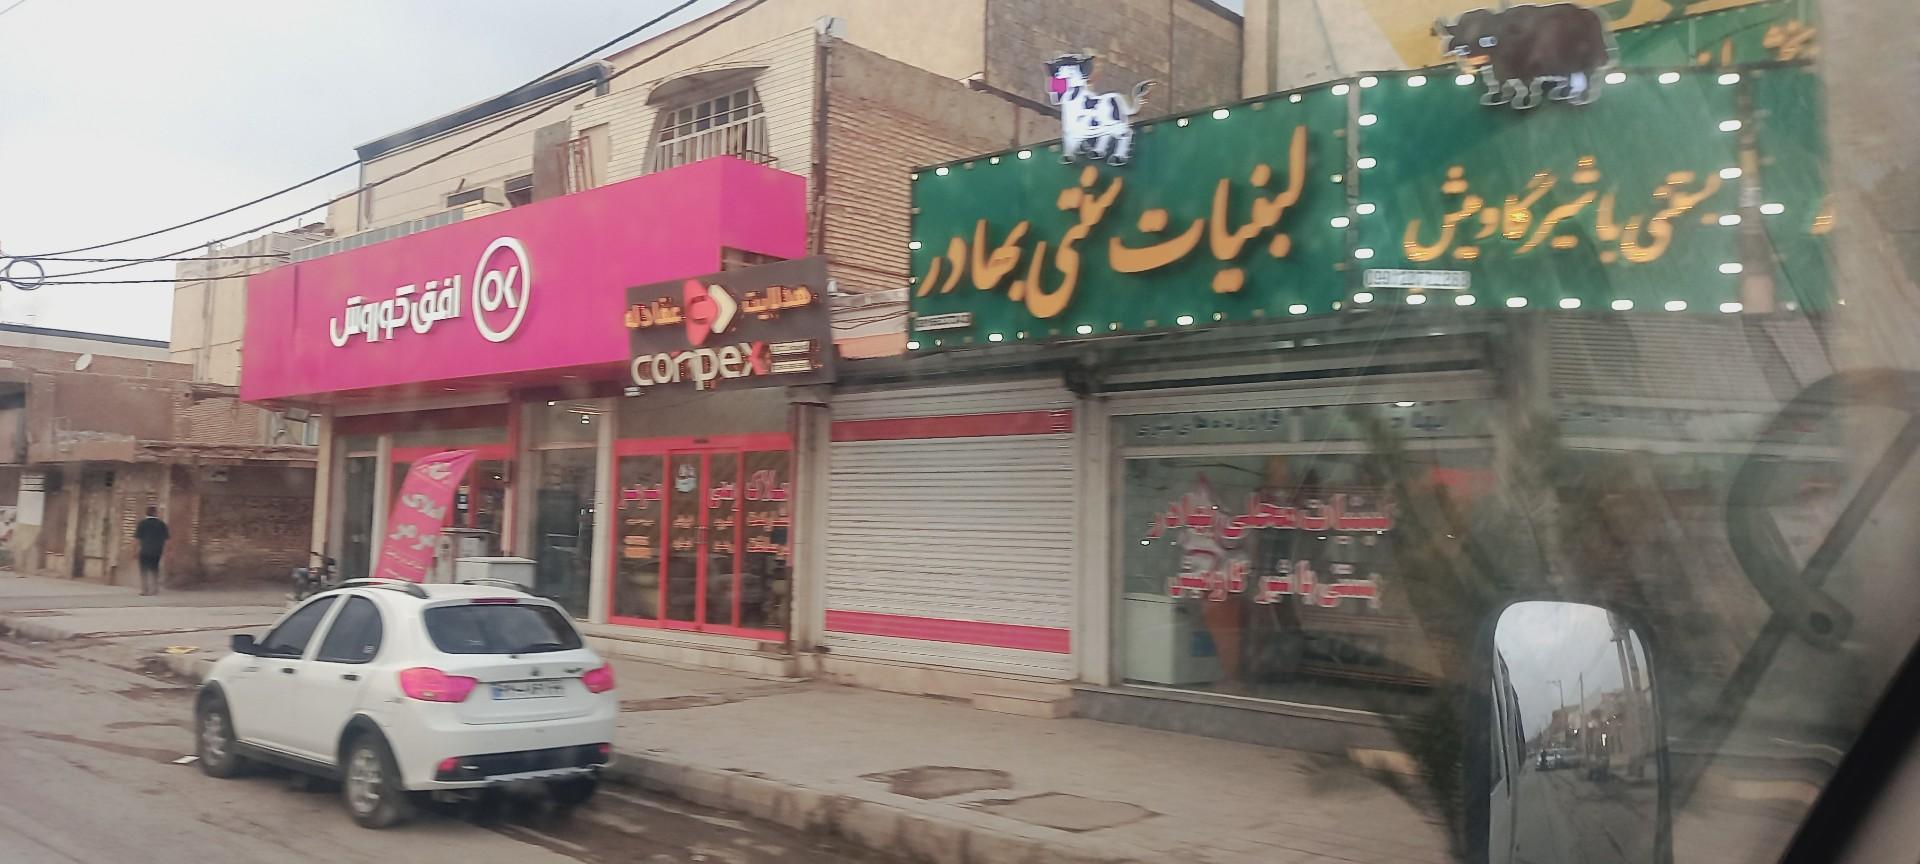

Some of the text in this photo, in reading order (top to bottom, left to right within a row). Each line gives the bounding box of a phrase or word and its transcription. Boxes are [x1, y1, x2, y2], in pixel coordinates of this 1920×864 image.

[916, 124, 1308, 319] لبنیات سنتی بهادر
[1512, 155, 1600, 256] شیر
[1597, 192, 1620, 263] با
[1619, 169, 1722, 263] بستنی
[329, 274, 462, 348] افق کوروش
[480, 265, 520, 312] OK
